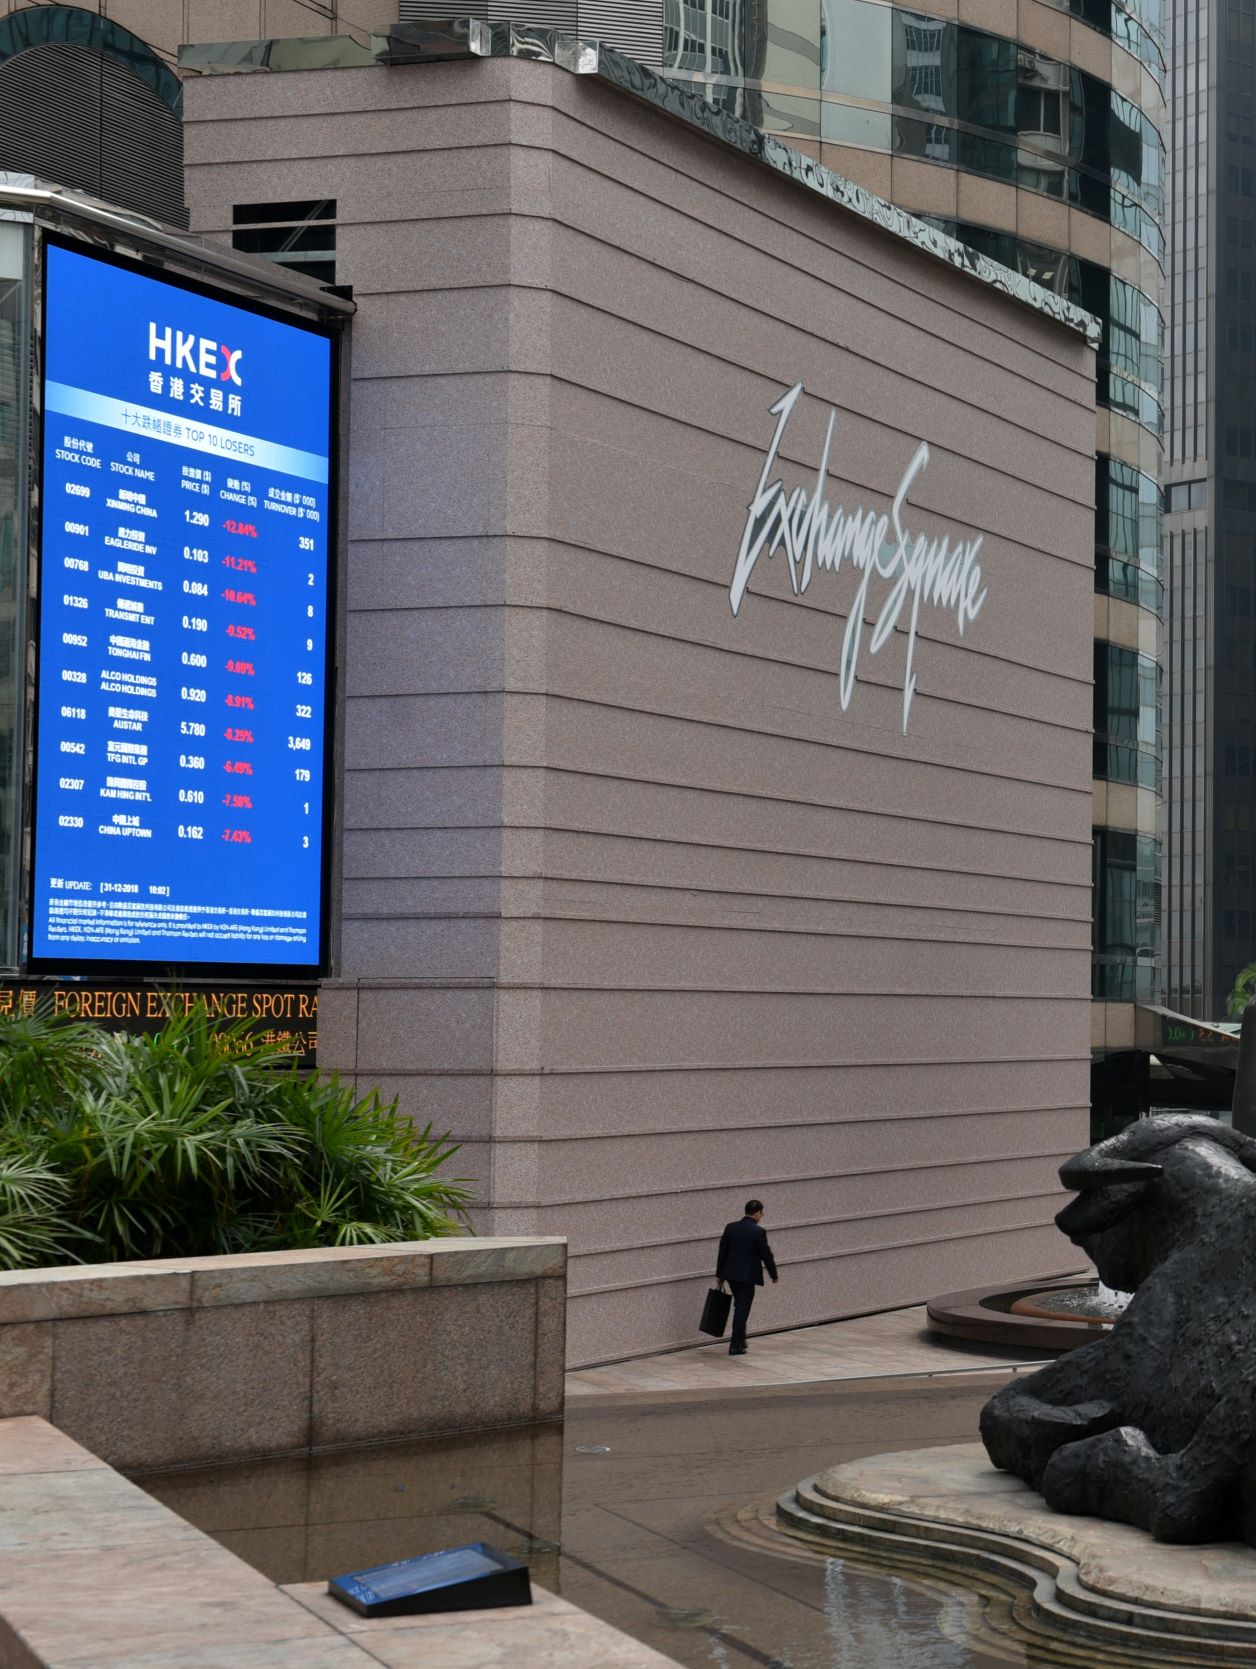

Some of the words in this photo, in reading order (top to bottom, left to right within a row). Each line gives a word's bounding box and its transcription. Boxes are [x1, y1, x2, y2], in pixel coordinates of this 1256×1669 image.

[149, 322, 242, 386] HKEX
[149, 371, 242, 416] 香港交易所
[122, 409, 182, 438] 十大跌幅證券
[186, 427, 205, 443] TOP
[208, 433, 218, 446] 10
[220, 436, 256, 457] LOSERS
[64, 436, 94, 453] 股份代號
[56, 449, 80, 464] STOCK
[81, 456, 102, 469] CODE
[126, 452, 140, 464] 公司
[110, 462, 134, 476] STOCK
[135, 469, 155, 481] NAME
[66, 483, 90, 498] 02699
[181, 480, 200, 492] PRICE
[220, 490, 246, 504] CHANGE
[106, 498, 135, 512] XINMING
[136, 505, 158, 518] CHINA
[264, 500, 296, 516] TURNOVER
[185, 510, 209, 526] 1.290
[65, 522, 89, 536] 00901
[105, 536, 144, 552] EAGLERIDE
[146, 545, 157, 555] INV
[299, 536, 314, 550] 351
[184, 546, 208, 563] 0.103
[729, 380, 890, 712] Exchange
[869, 440, 987, 736] Square
[64, 557, 89, 571] 00768
[98, 570, 114, 581] UBA
[115, 574, 163, 591] INVESTMENTS
[308, 574, 314, 586] 2
[183, 580, 208, 596] 0.084
[64, 595, 88, 609] 01326
[105, 608, 140, 623] TRANSMIT
[141, 615, 155, 625] ENT
[307, 605, 314, 617] 8
[182, 616, 208, 632] 0.190
[63, 633, 87, 647] 00952
[306, 639, 313, 651] 9
[108, 646, 140, 660] TONGHAI
[140, 651, 151, 662] FIN
[182, 652, 207, 668] 0.600
[62, 670, 87, 683] 00328
[101, 670, 121, 681] ALCO
[122, 672, 157, 686] HOLDINGS
[297, 672, 312, 685] 126
[101, 682, 121, 692] ALCO
[122, 684, 156, 698] HOLDINGS
[181, 687, 206, 702] 0.920
[61, 706, 86, 720] 06118
[296, 705, 312, 718] 322
[113, 720, 142, 732] AUSTAR
[180, 722, 206, 736] 5.780
[60, 741, 85, 754] 00542
[288, 736, 311, 751] 3,649
[107, 753, 122, 763] TFG
[138, 755, 148, 766] GP
[180, 755, 205, 770] 0.360
[295, 769, 310, 782] 179
[60, 778, 85, 790] 02307
[100, 789, 117, 798] KAM
[118, 790, 135, 800] HING
[179, 790, 204, 804] 0.610
[304, 803, 309, 814] 1
[59, 816, 84, 827] 02330
[99, 826, 121, 836] CHINA
[122, 827, 152, 838] UPTOWN
[178, 825, 203, 839] 0.162
[303, 836, 309, 848] 3
[50, 878, 64, 889] 更新
[54, 991, 141, 1018] FOREIGN
[146, 992, 248, 1018] EXCHANGE
[252, 993, 295, 1018] SPOT
